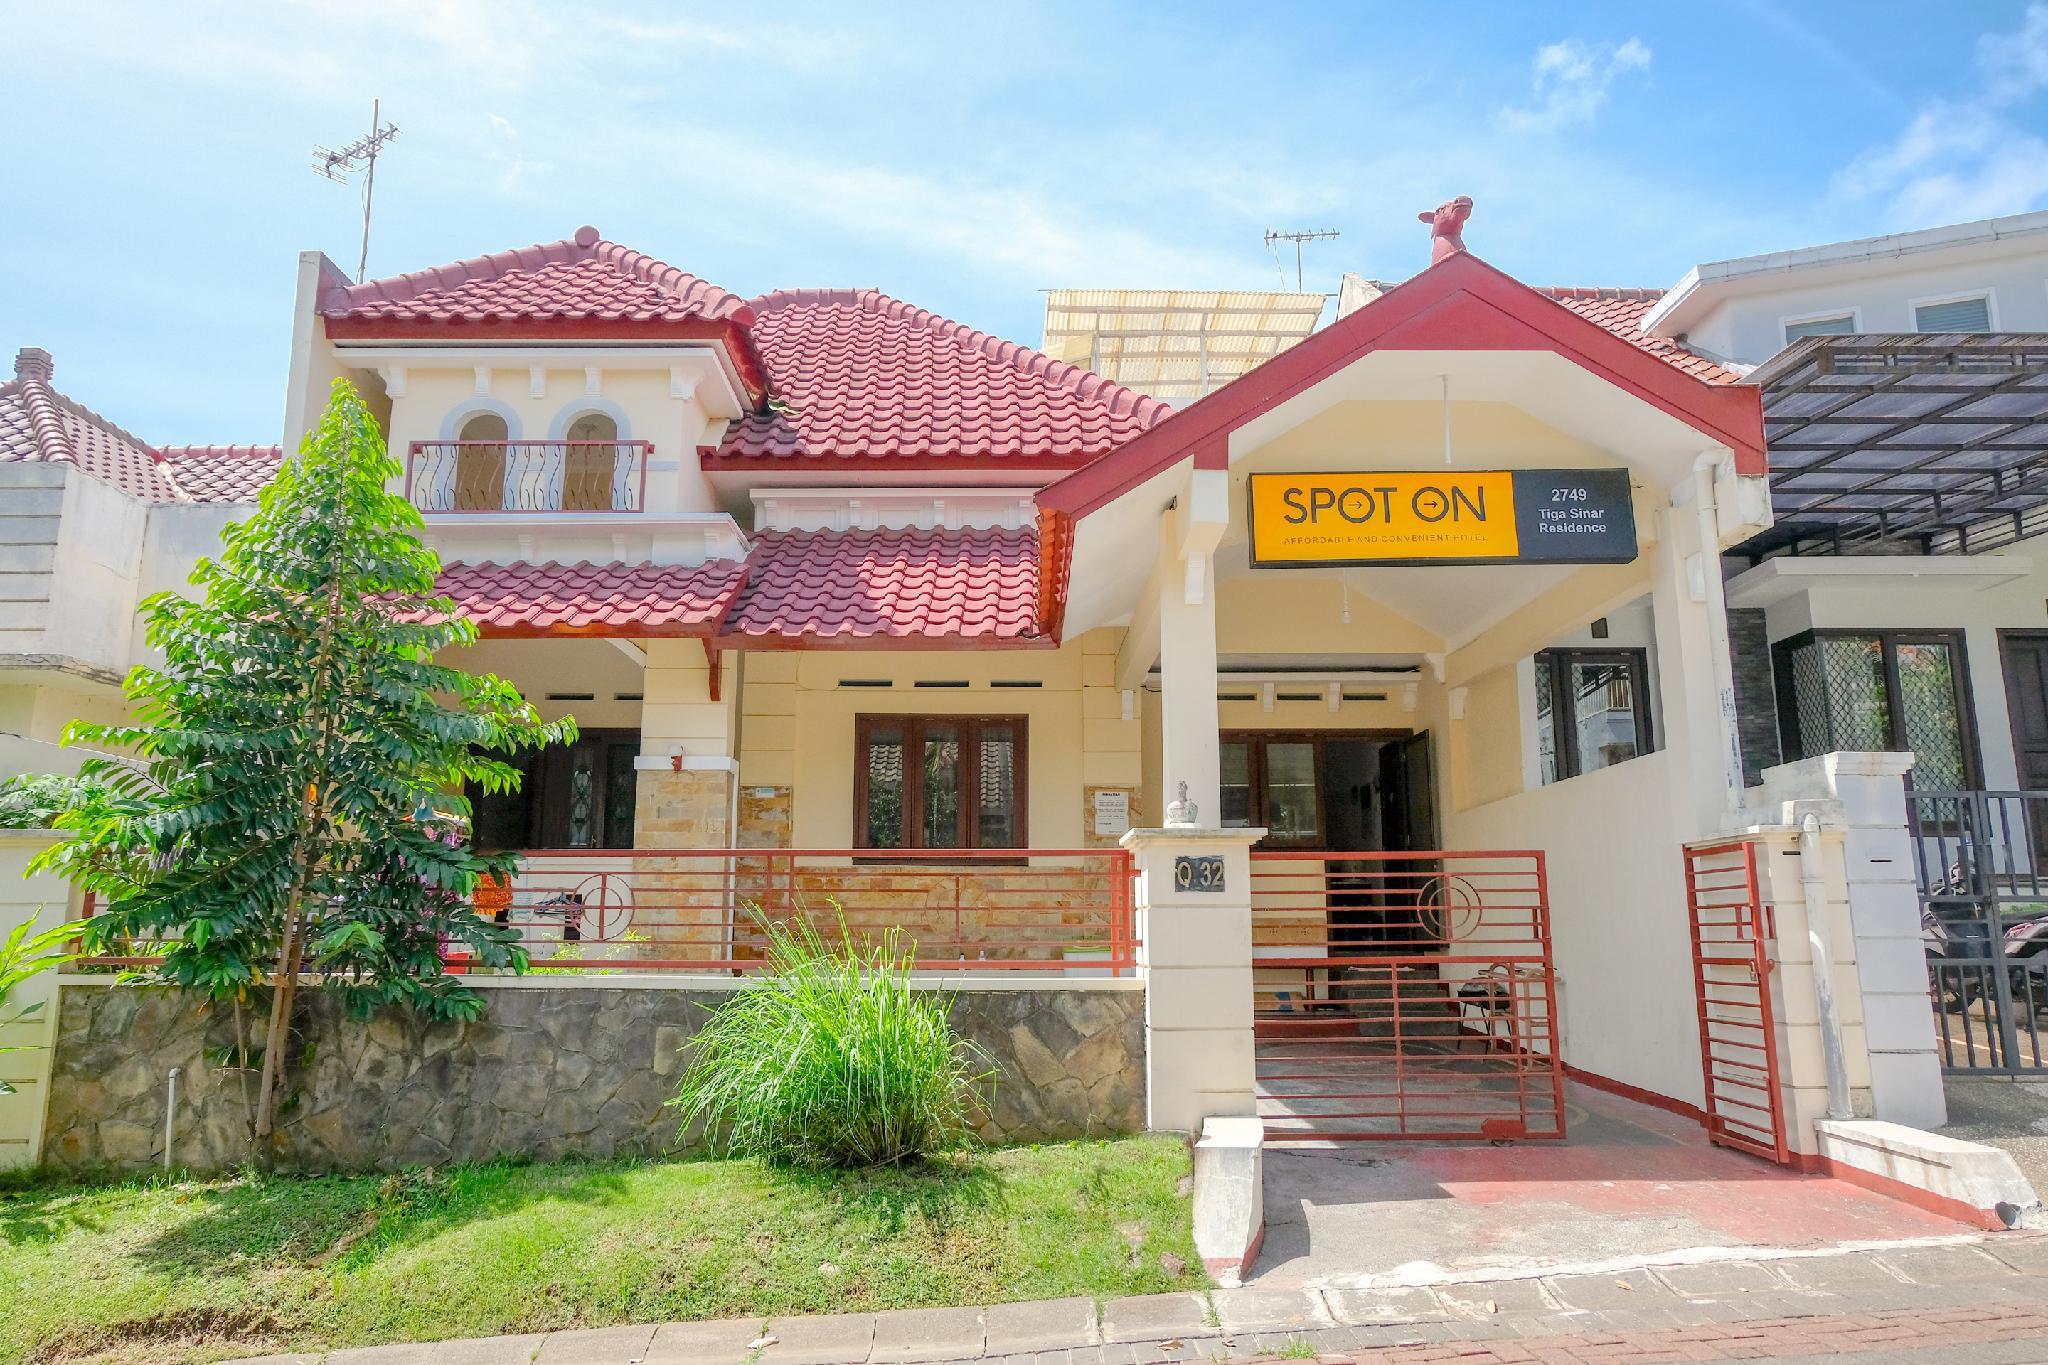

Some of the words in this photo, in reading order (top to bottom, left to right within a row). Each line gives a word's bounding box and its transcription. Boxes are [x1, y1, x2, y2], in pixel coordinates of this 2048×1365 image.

[1551, 488, 1587, 502] 2749
[1283, 487, 1397, 524] SPOT
[1411, 486, 1487, 522] ON
[1538, 508, 1566, 521] Tiga
[1569, 508, 1605, 519] Sinar
[1539, 522, 1607, 533] Residence
